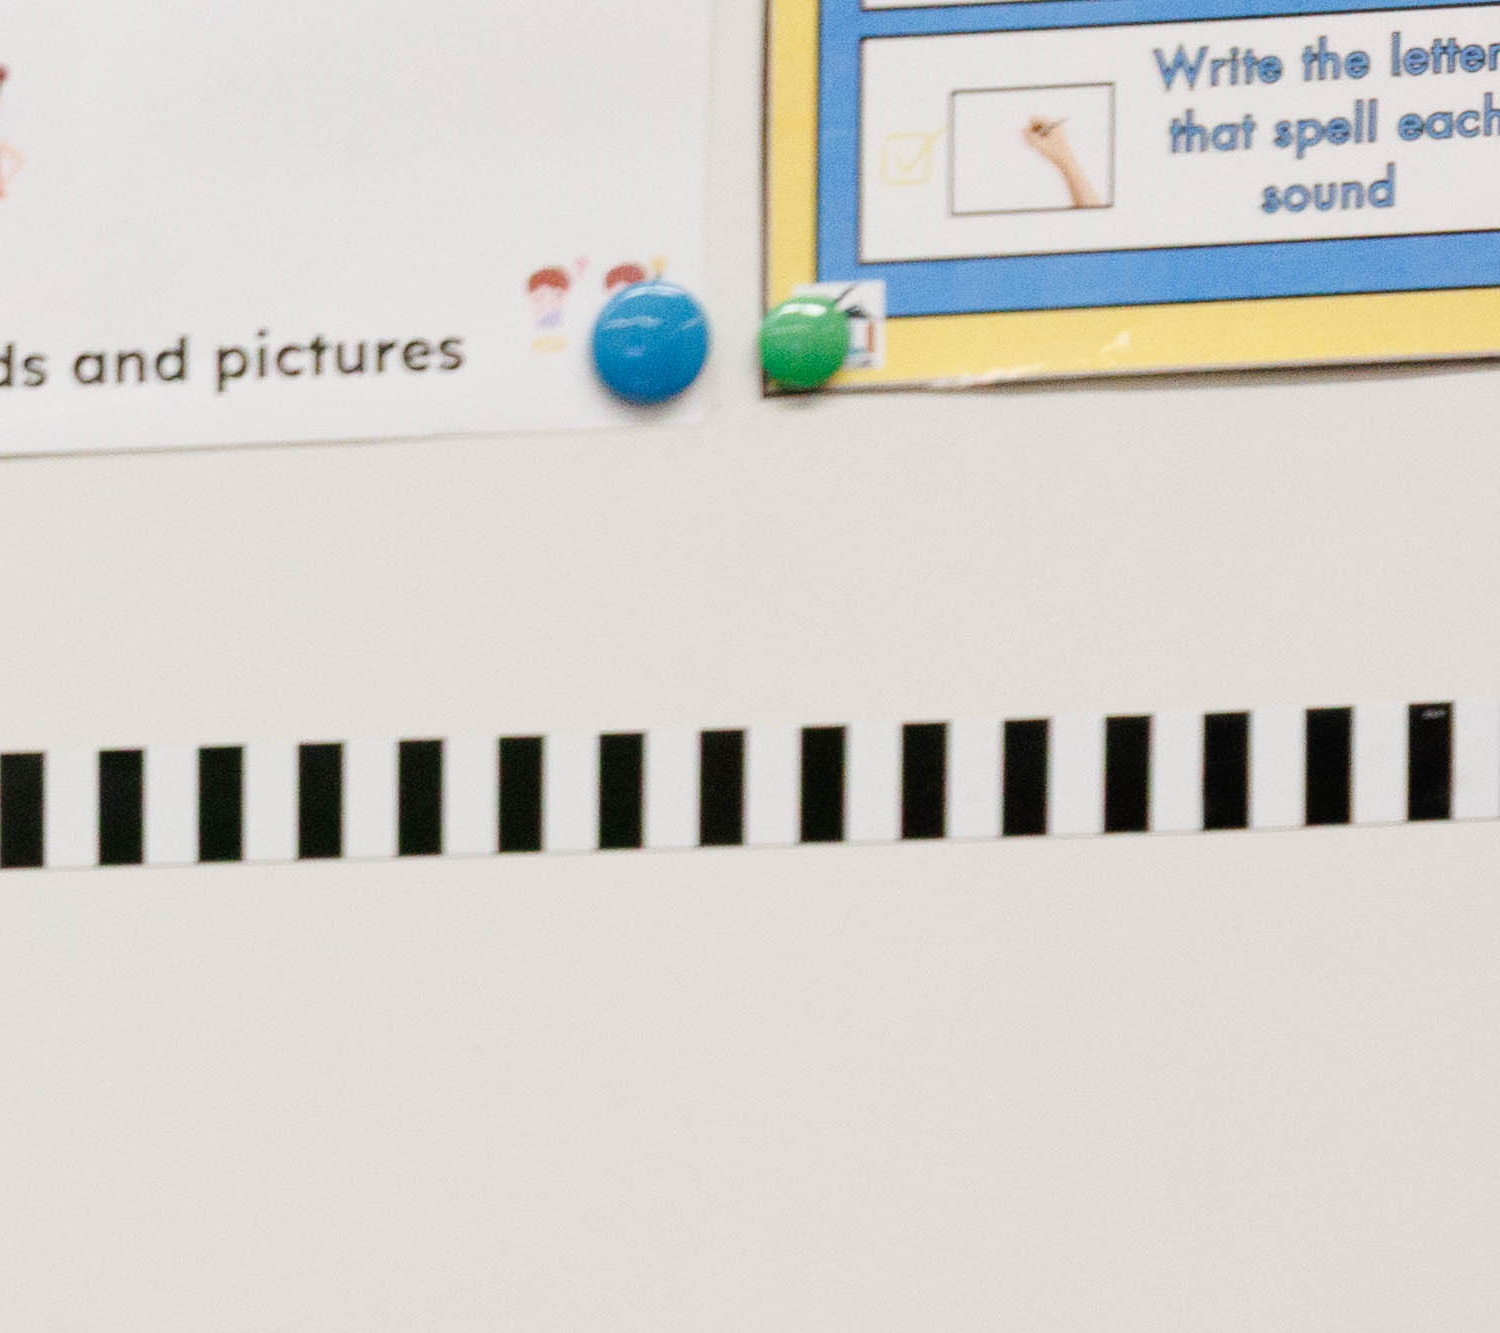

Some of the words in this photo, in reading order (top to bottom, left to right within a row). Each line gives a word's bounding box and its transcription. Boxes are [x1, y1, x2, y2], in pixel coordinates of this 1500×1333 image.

[1153, 43, 1283, 91] Write
[1301, 36, 1371, 82] the
[1170, 110, 1257, 155] that
[1273, 99, 1379, 160] spell
[1260, 163, 1398, 216] sound
[72, 335, 189, 387] and
[214, 327, 465, 393] pictures
